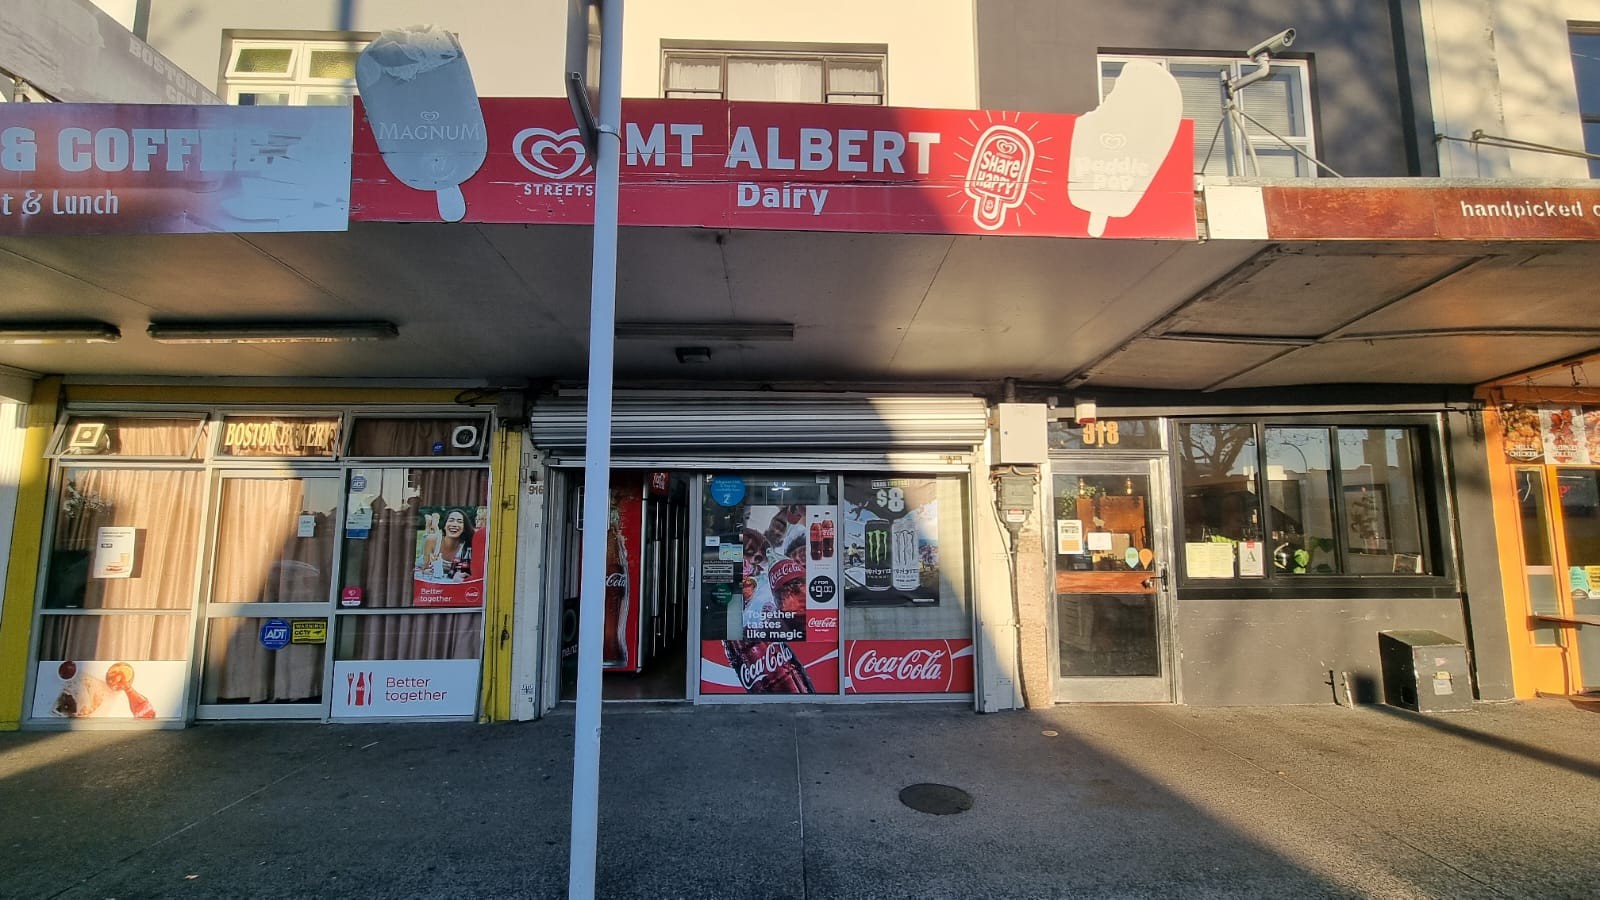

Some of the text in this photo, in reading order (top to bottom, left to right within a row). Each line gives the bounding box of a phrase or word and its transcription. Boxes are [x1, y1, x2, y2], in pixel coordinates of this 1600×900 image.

[379, 122, 481, 141] MAGNUM
[0, 127, 272, 172] & COFF
[625, 122, 942, 175] MT ALBERT
[523, 185, 595, 197] STREETS
[22, 190, 43, 216] &
[53, 190, 119, 215] Lunch
[737, 182, 829, 216] Dairy
[1460, 200, 1584, 218] handpicked
[225, 422, 278, 448] BOSTON
[1083, 421, 1120, 447] 918
[528, 485, 545, 496] 916
[876, 487, 905, 513] $8
[420, 587, 443, 595] Better
[420, 596, 453, 605] together
[748, 610, 798, 621] Together
[747, 620, 782, 630] tastes
[265, 629, 287, 640] ADT
[746, 629, 804, 641] like magic
[386, 676, 431, 688] Better
[385, 689, 448, 704] together
